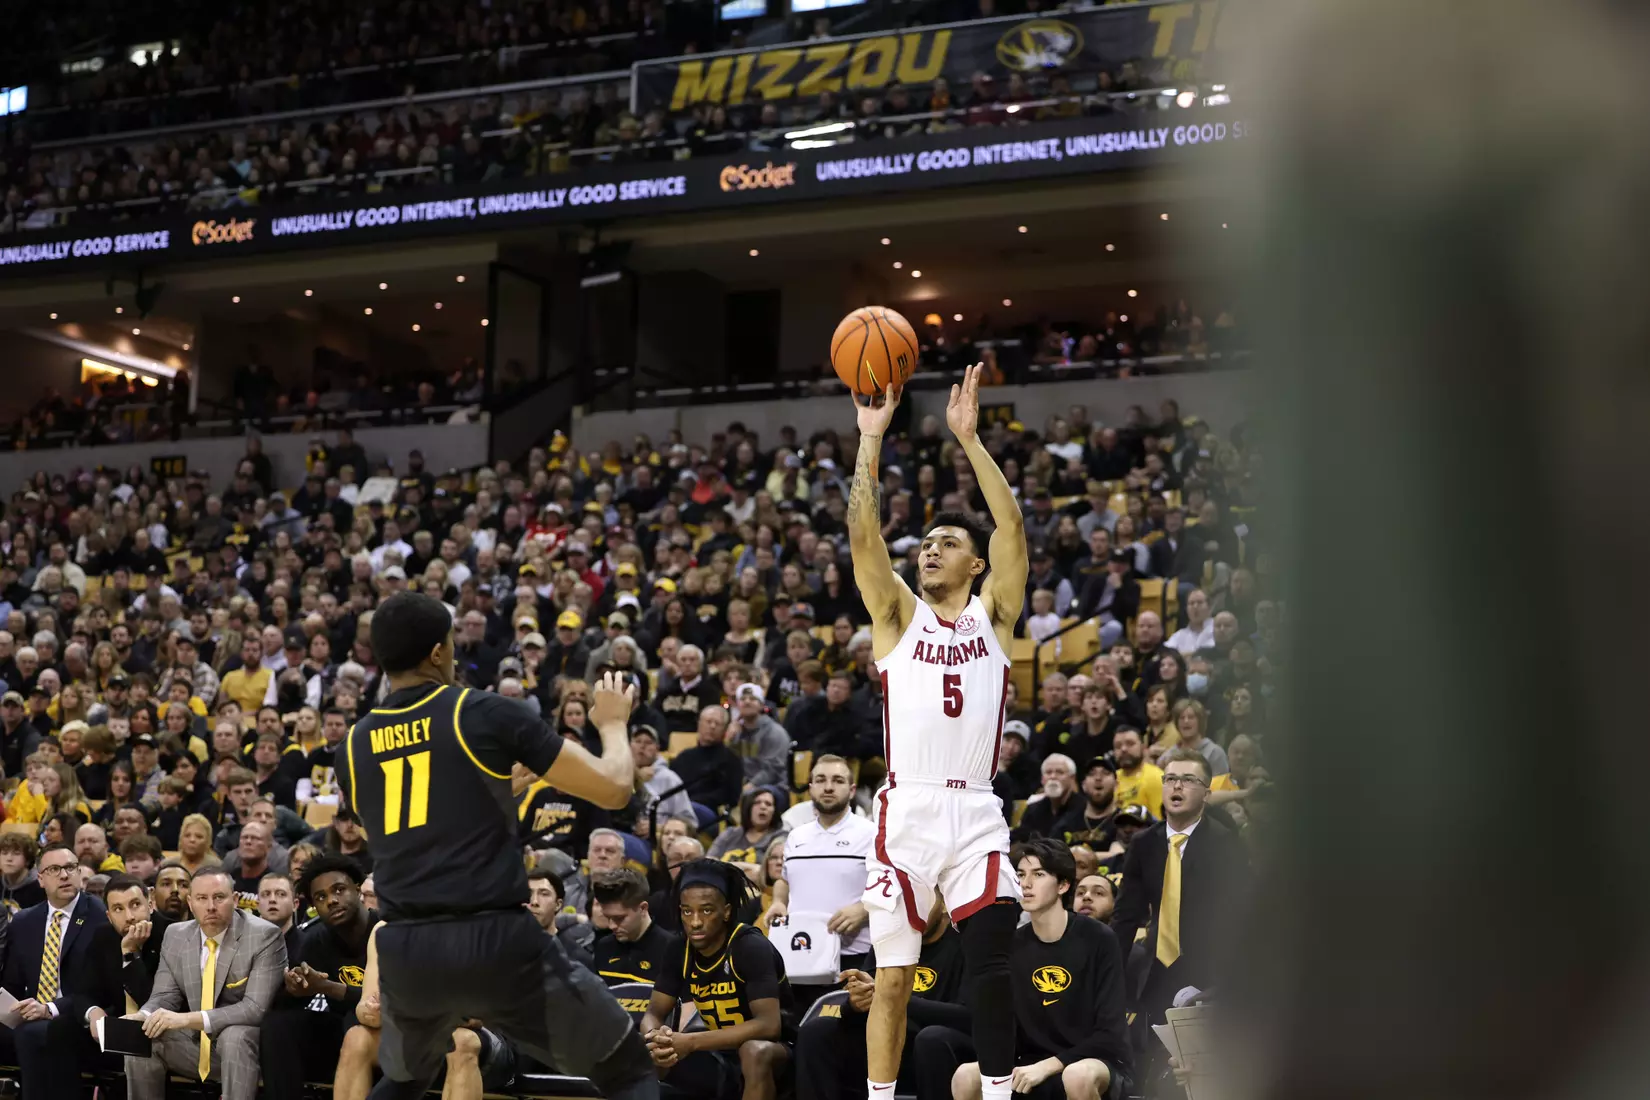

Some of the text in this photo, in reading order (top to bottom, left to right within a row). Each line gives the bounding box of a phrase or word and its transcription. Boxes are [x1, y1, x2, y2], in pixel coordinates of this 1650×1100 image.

[670, 30, 952, 111] MIZZOU
[817, 153, 914, 181] UNUSUALLY
[917, 148, 970, 171] GOOD
[973, 138, 1062, 166] INTERNET,
[1066, 127, 1168, 157] UNUSUALLY
[1173, 122, 1226, 146] GOOD
[271, 175, 687, 236] UNUSUALLY GOOD INTERNET, UNUSUALLY GOOD SERVICE
[0, 230, 170, 265] UNUSUALLY GOOD SERVICE
[943, 673, 963, 718] 5
[370, 717, 431, 754] MOSLEY
[380, 750, 431, 835] 11
[946, 779, 967, 789] RTR
[693, 998, 744, 1031] 55
